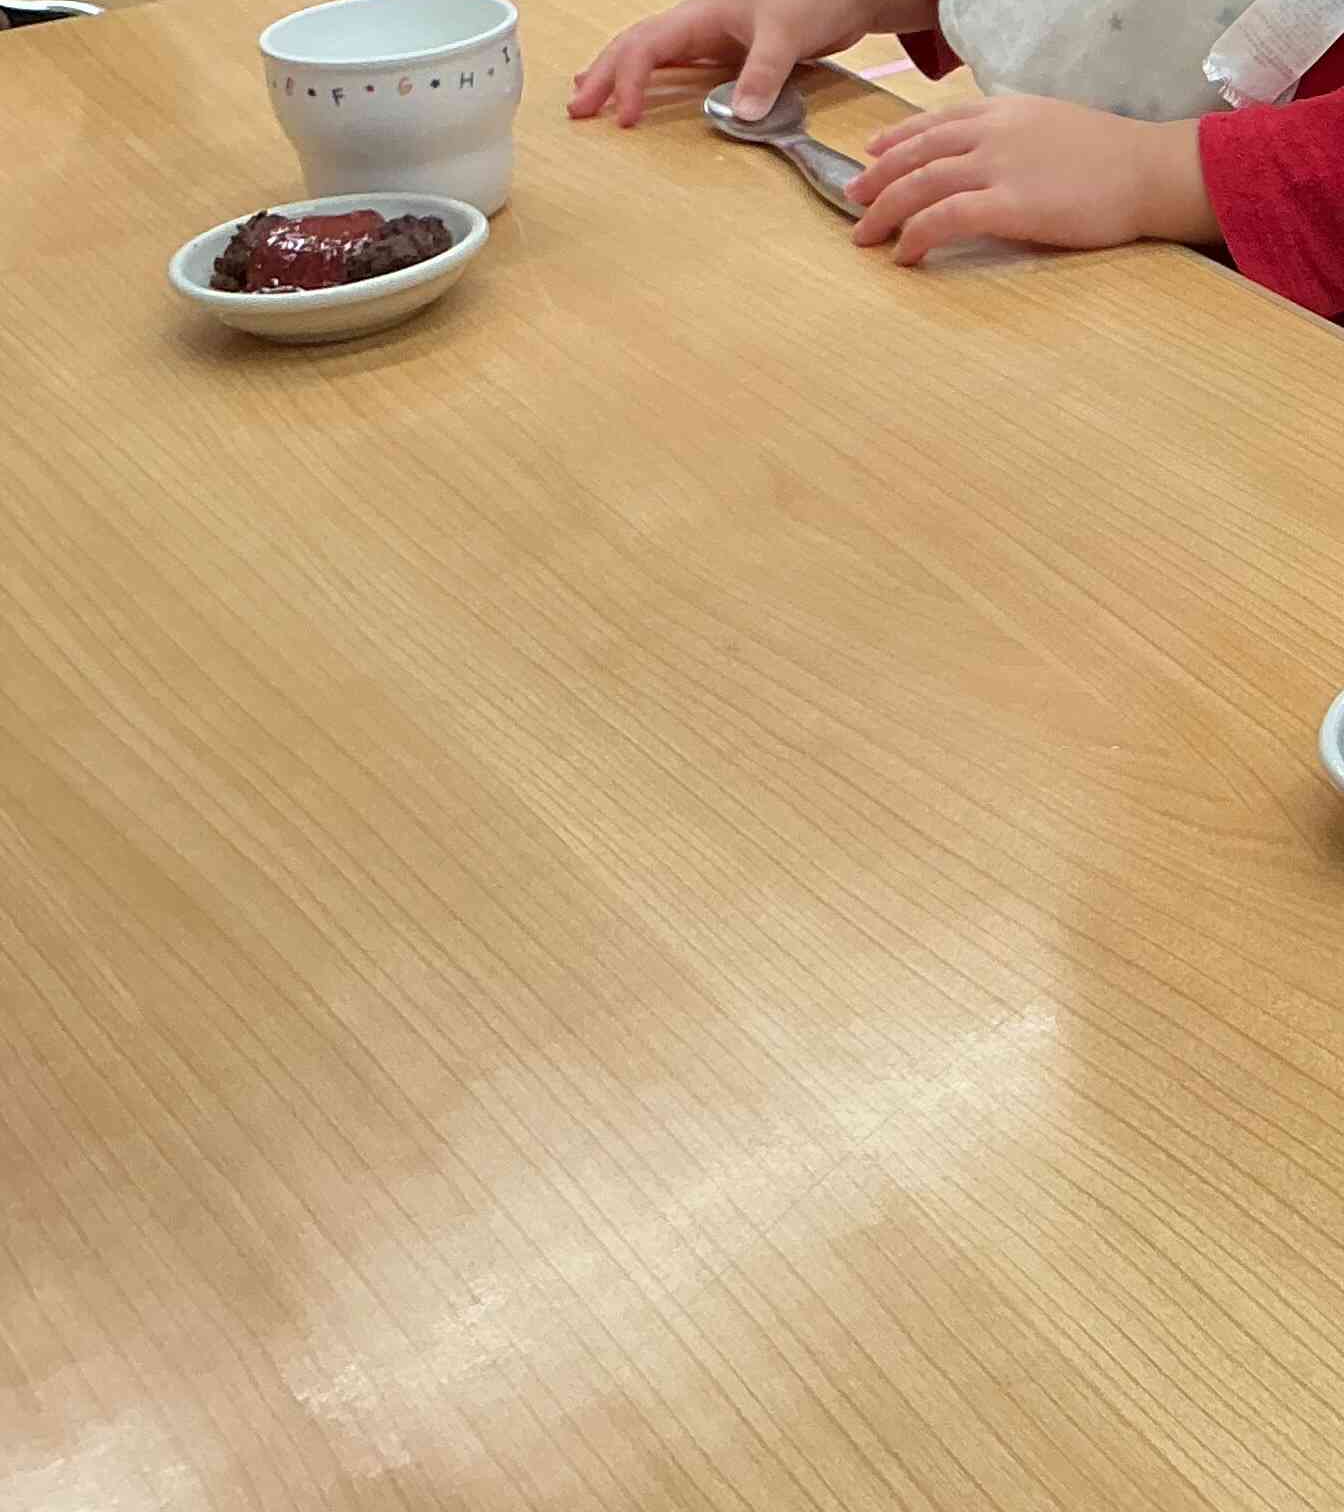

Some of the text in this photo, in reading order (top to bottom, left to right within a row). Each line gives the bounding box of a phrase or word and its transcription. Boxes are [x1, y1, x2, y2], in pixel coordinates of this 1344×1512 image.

[331, 88, 344, 106] F
[398, 76, 413, 96] G
[459, 71, 475, 89] H
